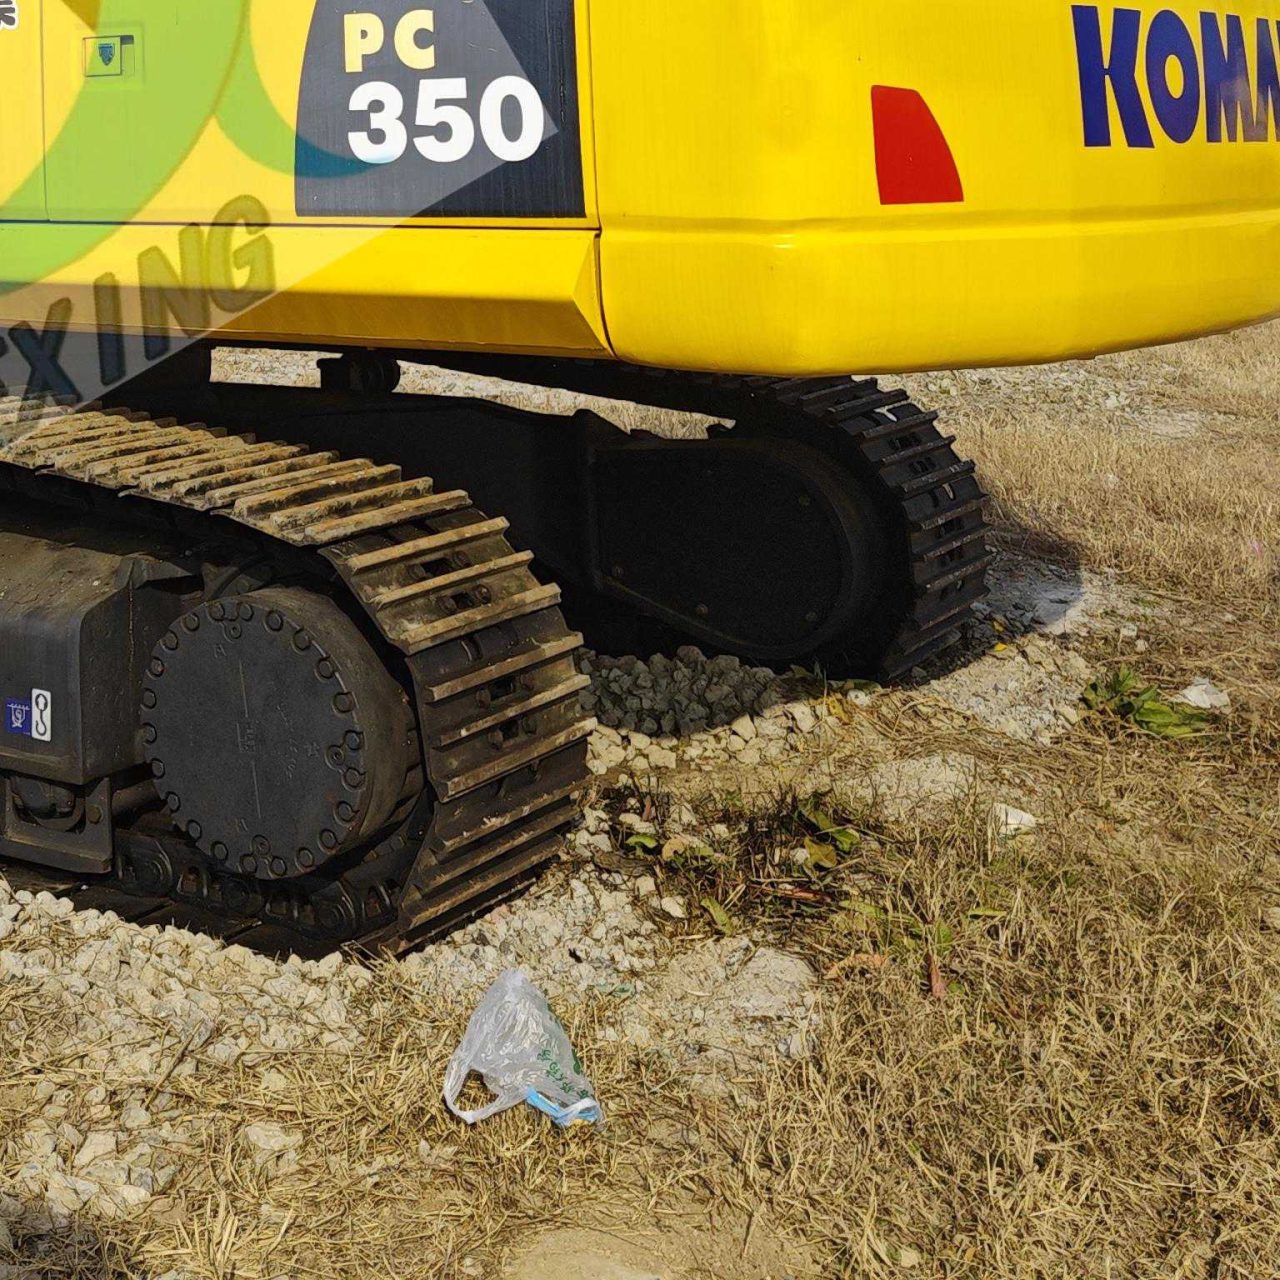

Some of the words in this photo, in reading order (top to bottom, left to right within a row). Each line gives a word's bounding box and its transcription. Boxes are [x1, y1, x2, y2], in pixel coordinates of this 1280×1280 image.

[343, 9, 435, 73] PC
[1071, 4, 1280, 148] KOMA
[347, 75, 544, 164] 350
